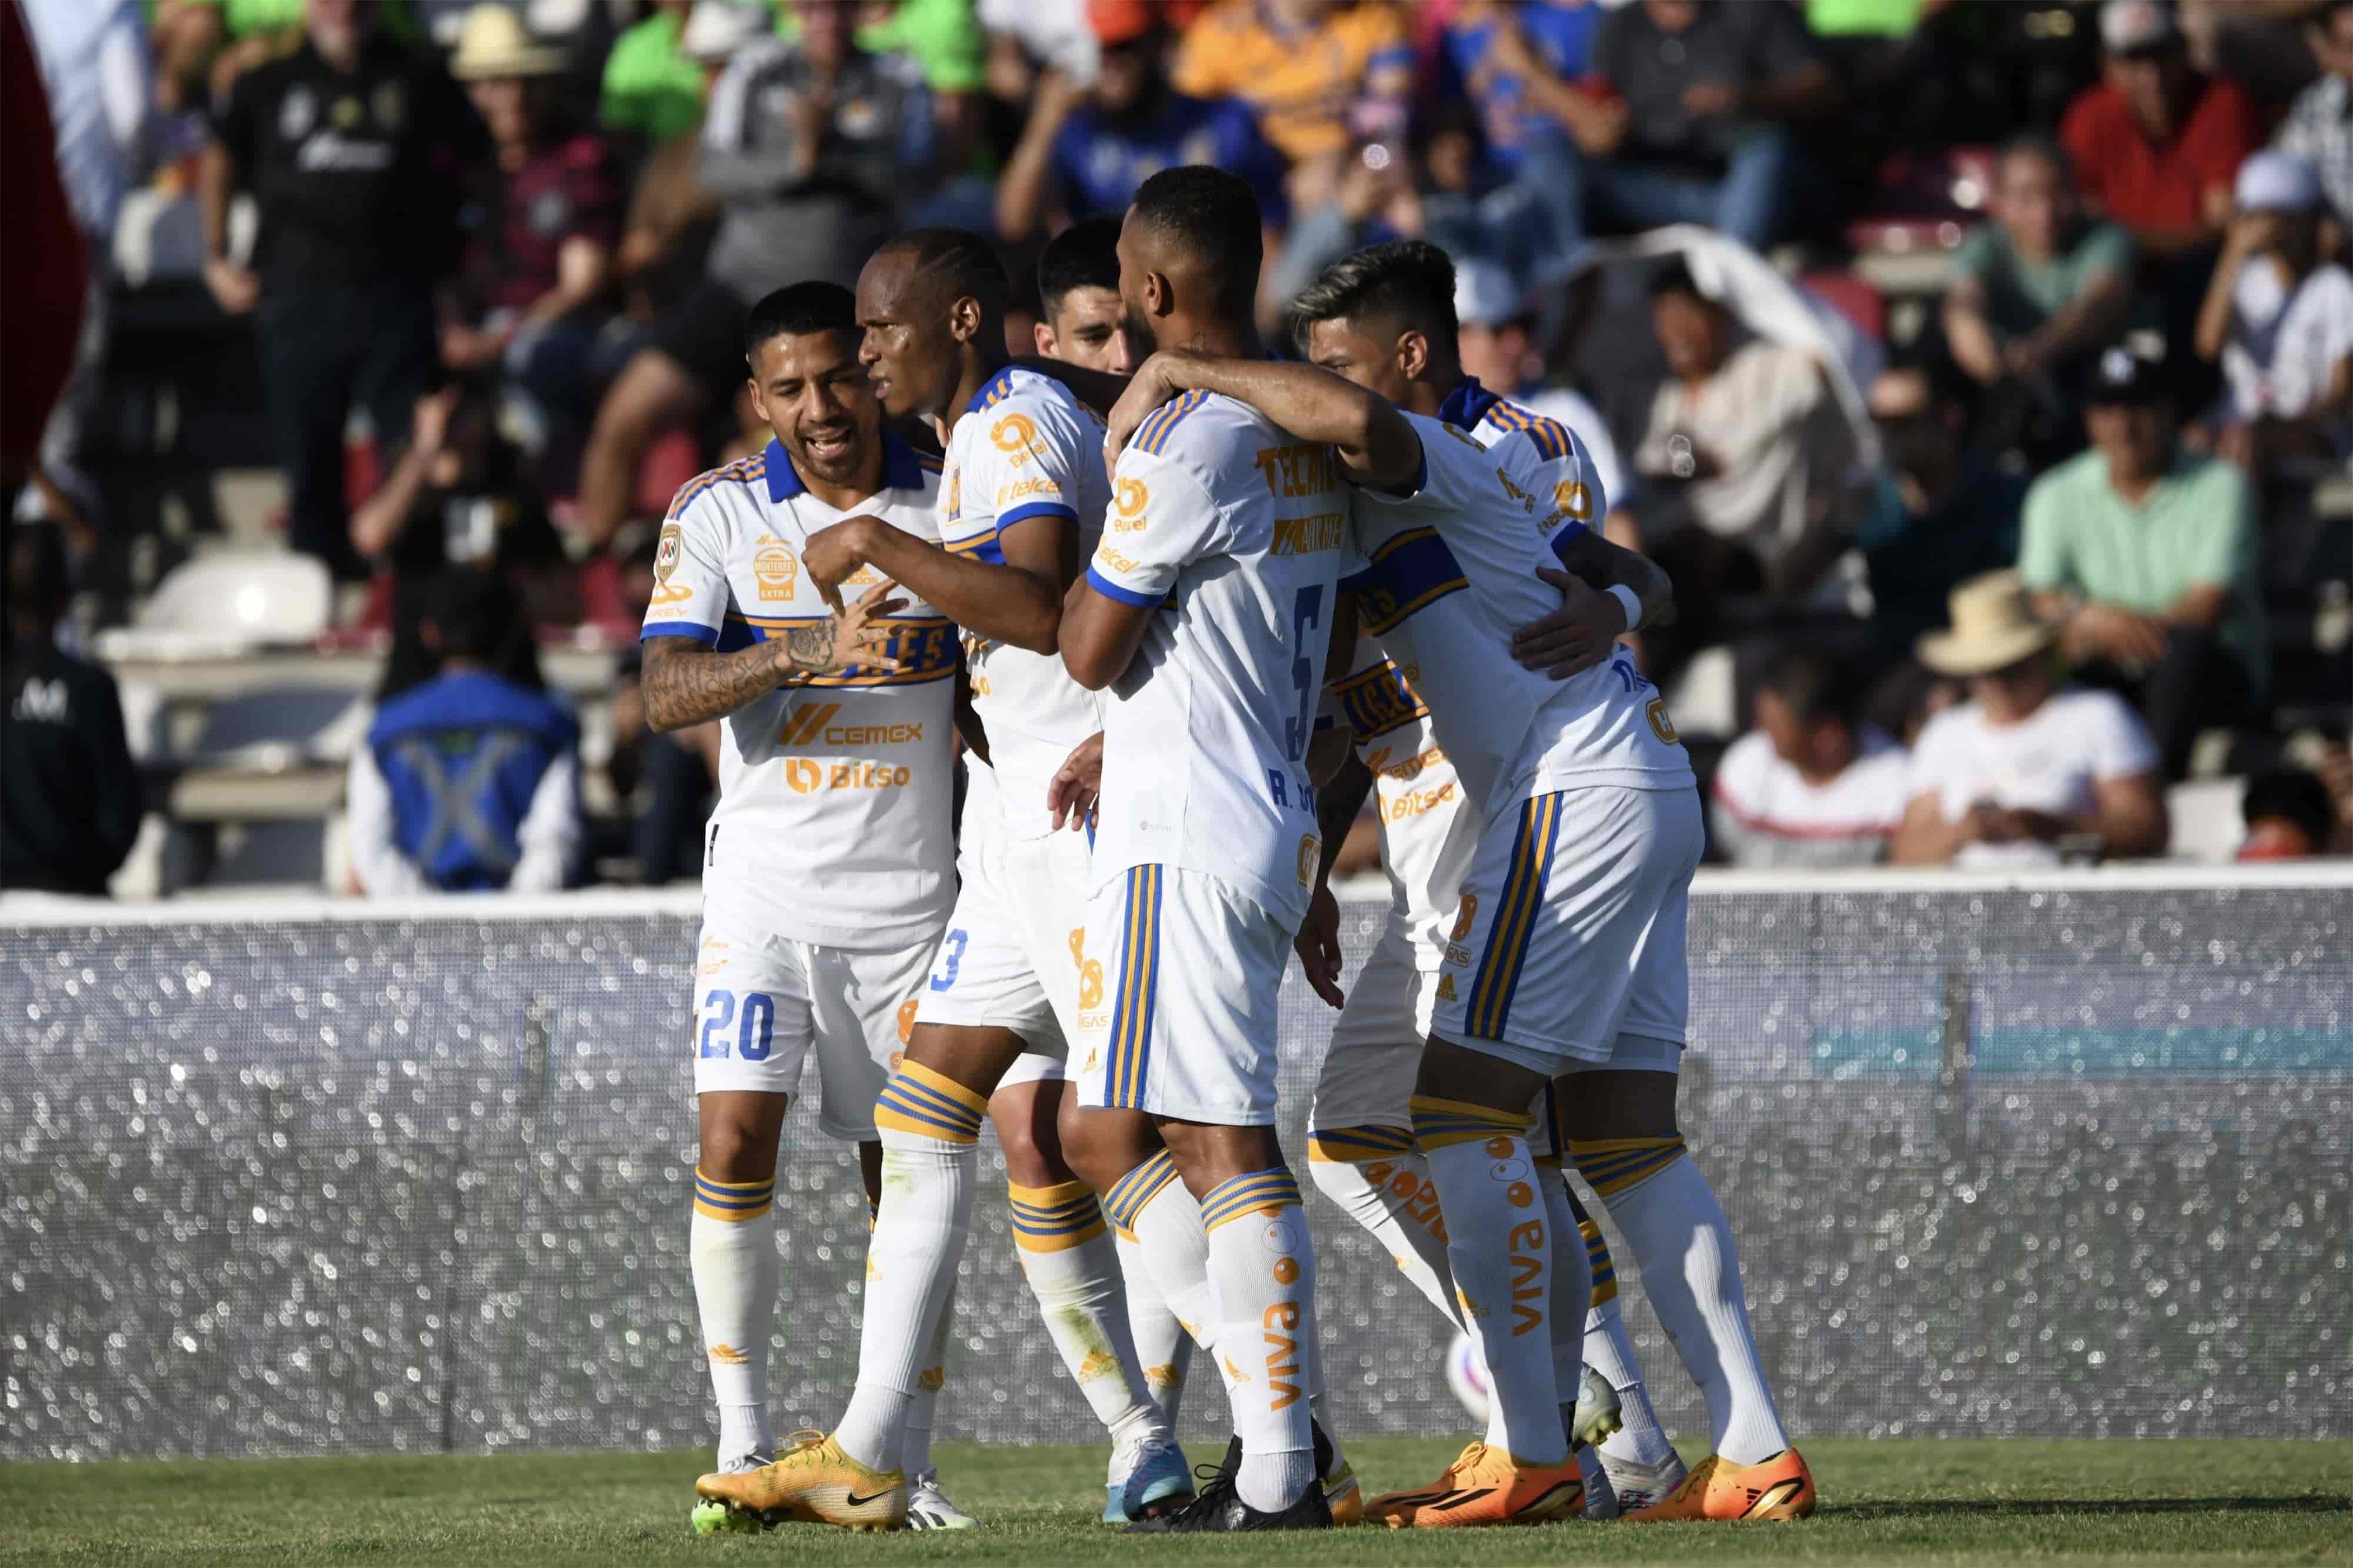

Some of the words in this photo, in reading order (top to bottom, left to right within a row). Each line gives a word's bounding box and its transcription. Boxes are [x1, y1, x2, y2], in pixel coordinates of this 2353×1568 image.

[761, 589, 791, 598] EXTRA
[825, 722, 922, 745] CEMEX
[830, 761, 910, 789] Bitso
[1392, 783, 1454, 819] Bitso
[931, 928, 968, 993] 3
[701, 989, 775, 1061] 20
[1508, 1219, 1544, 1337] viva
[1263, 1301, 1301, 1412] viva
